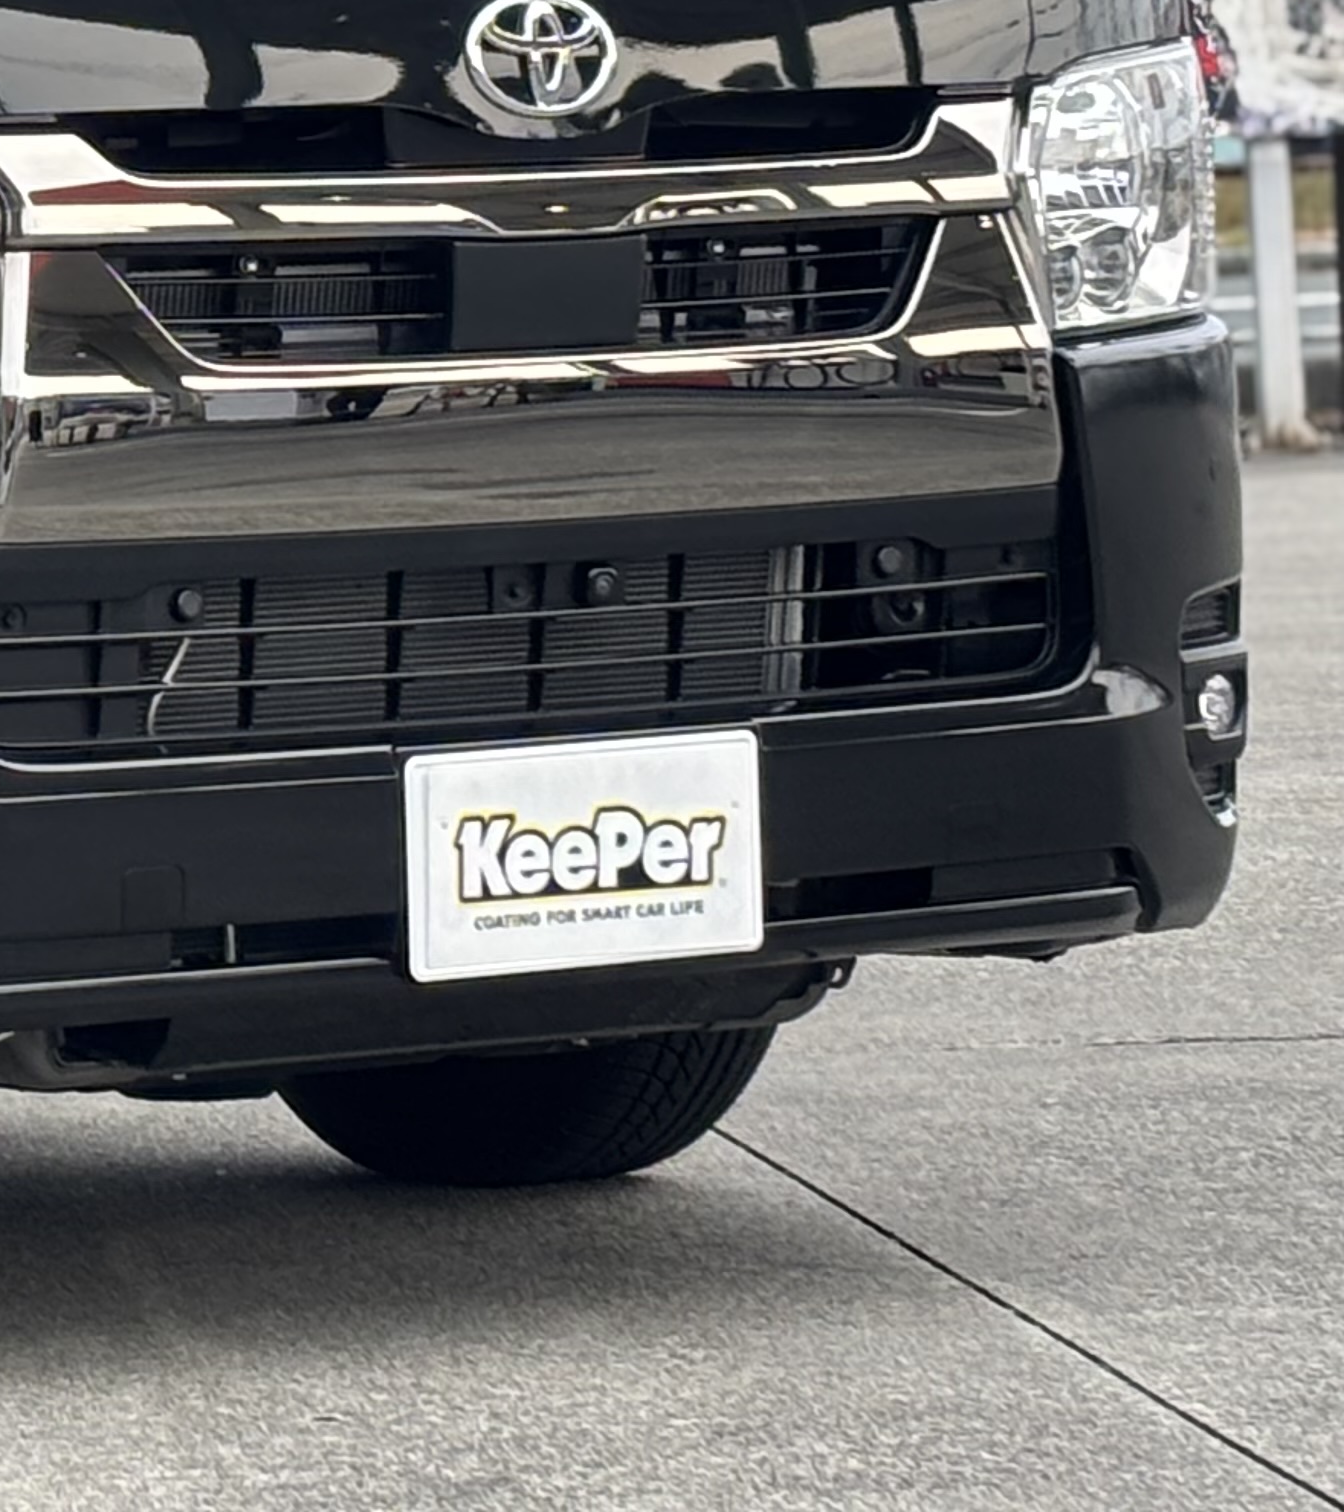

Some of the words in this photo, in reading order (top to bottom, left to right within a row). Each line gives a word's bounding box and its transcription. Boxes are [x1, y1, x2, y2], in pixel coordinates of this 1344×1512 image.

[454, 805, 726, 903] KeePer
[474, 910, 541, 932] COATING
[547, 908, 577, 925] FOR
[581, 904, 633, 923] SMART
[636, 902, 666, 918] CAR
